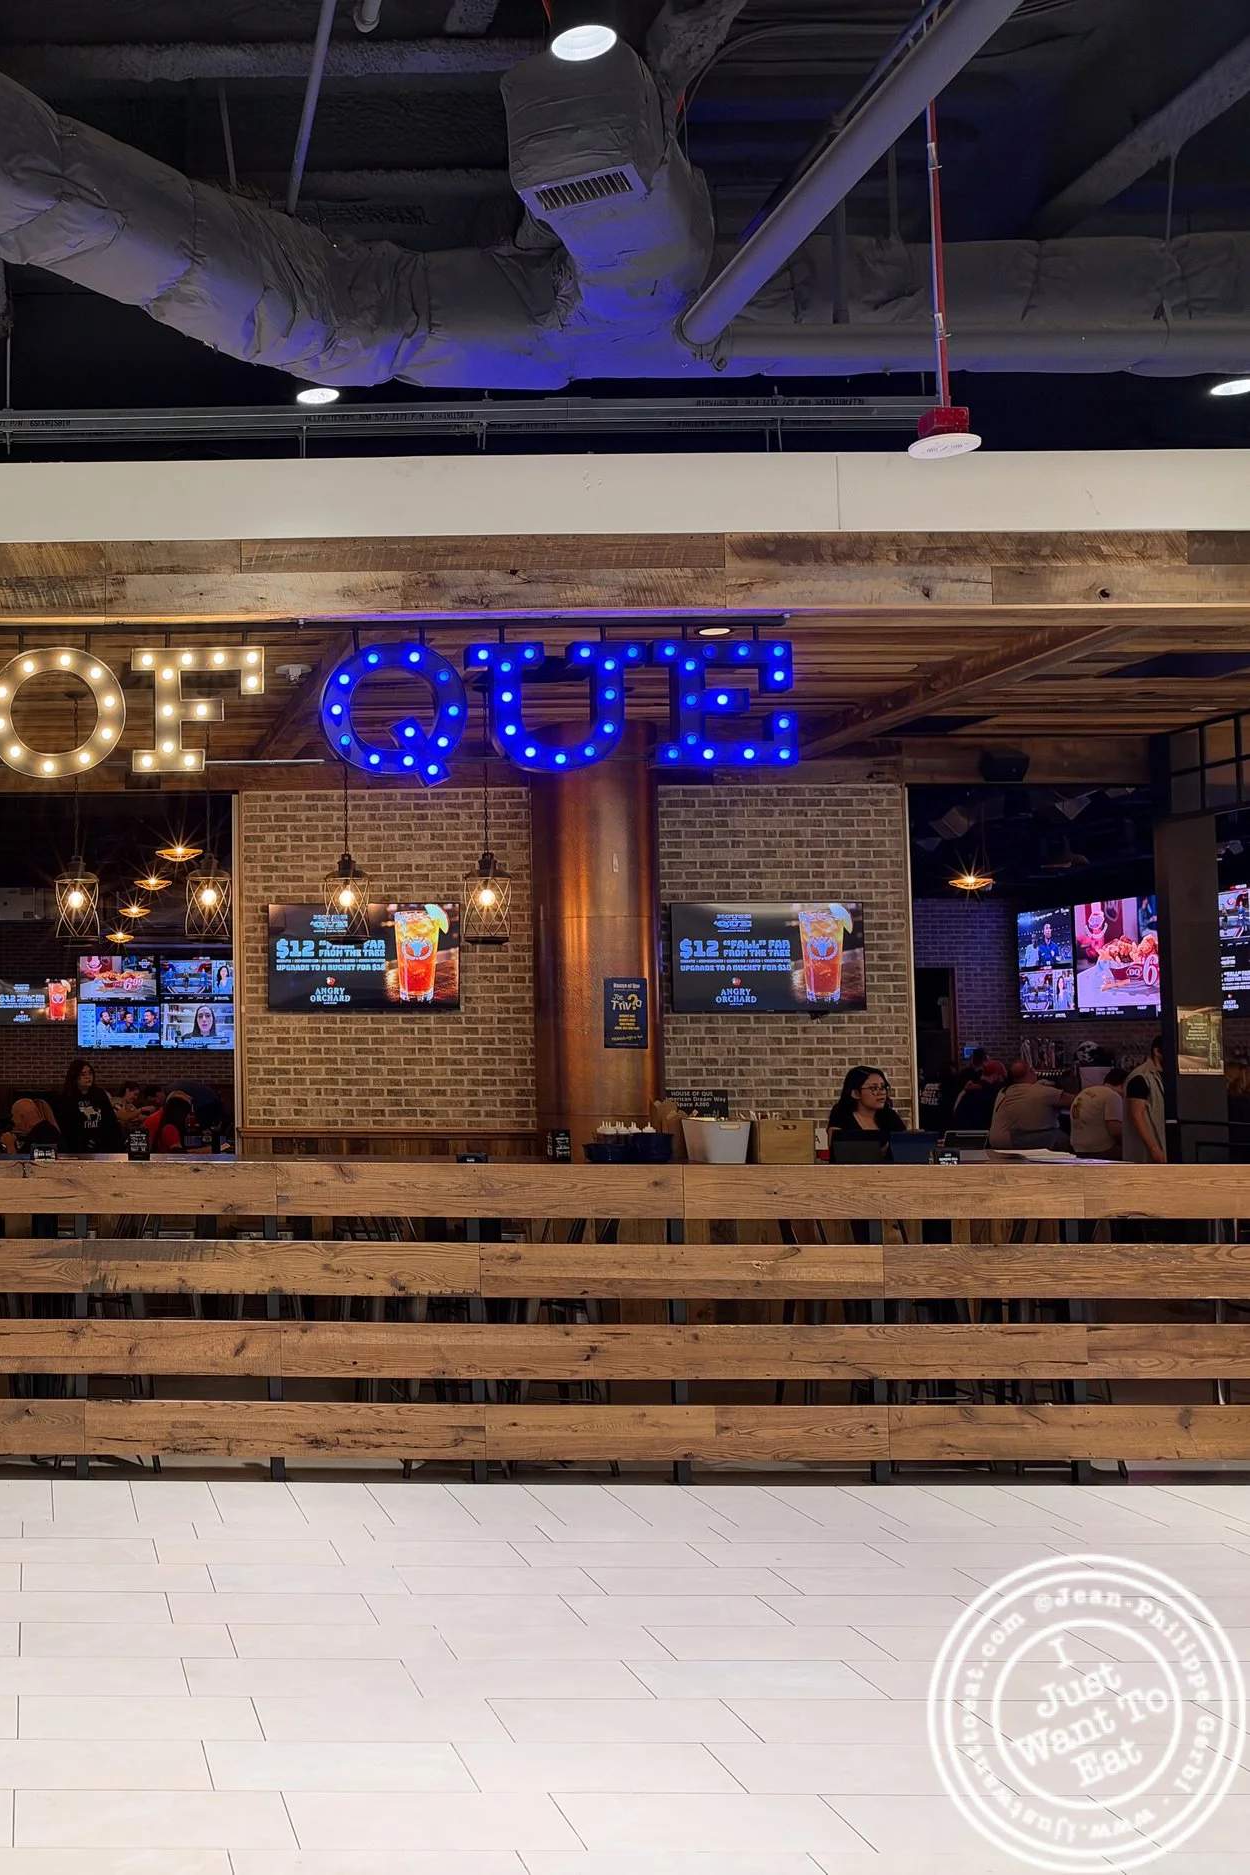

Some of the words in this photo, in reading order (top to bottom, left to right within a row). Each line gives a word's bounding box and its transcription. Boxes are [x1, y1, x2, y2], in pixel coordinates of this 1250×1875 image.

[321, 640, 799, 788] QUE
[276, 938, 315, 959] $12
[363, 939, 386, 949] FAR
[319, 949, 343, 957] FROM
[344, 949, 362, 957] THE
[362, 949, 386, 957] TREE
[679, 938, 719, 959] $12
[768, 939, 791, 949] FAR
[723, 949, 748, 957] FROM
[749, 949, 767, 957] THE
[768, 949, 791, 957] TREE
[315, 987, 345, 995] ANGRY
[720, 987, 752, 996] ANGRY
[309, 994, 351, 1003] ORCHARD
[715, 995, 757, 1003] ORCHARD
